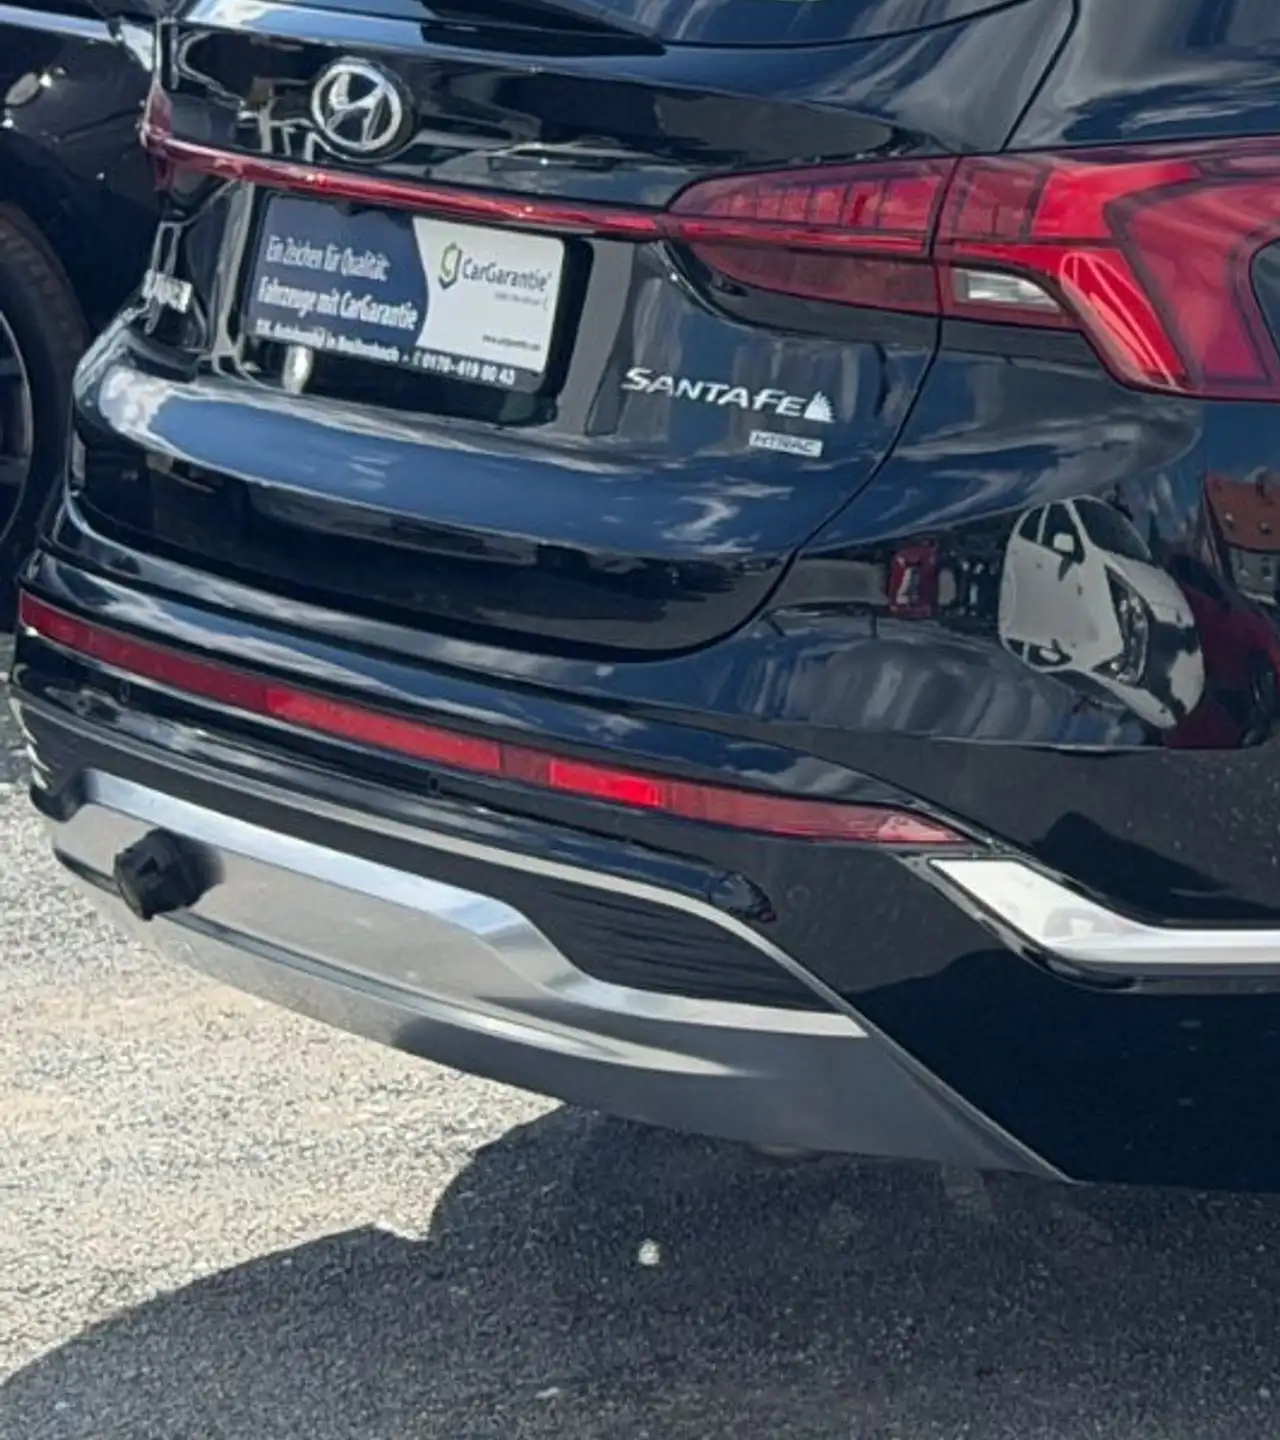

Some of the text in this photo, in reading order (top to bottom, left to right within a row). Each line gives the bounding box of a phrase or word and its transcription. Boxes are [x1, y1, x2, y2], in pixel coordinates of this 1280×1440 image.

[266, 234, 283, 262] Ein
[283, 236, 323, 270] Zeichen
[462, 257, 549, 293] CarGarantie
[257, 275, 419, 331] Fahrzeuge mit CarGarantie
